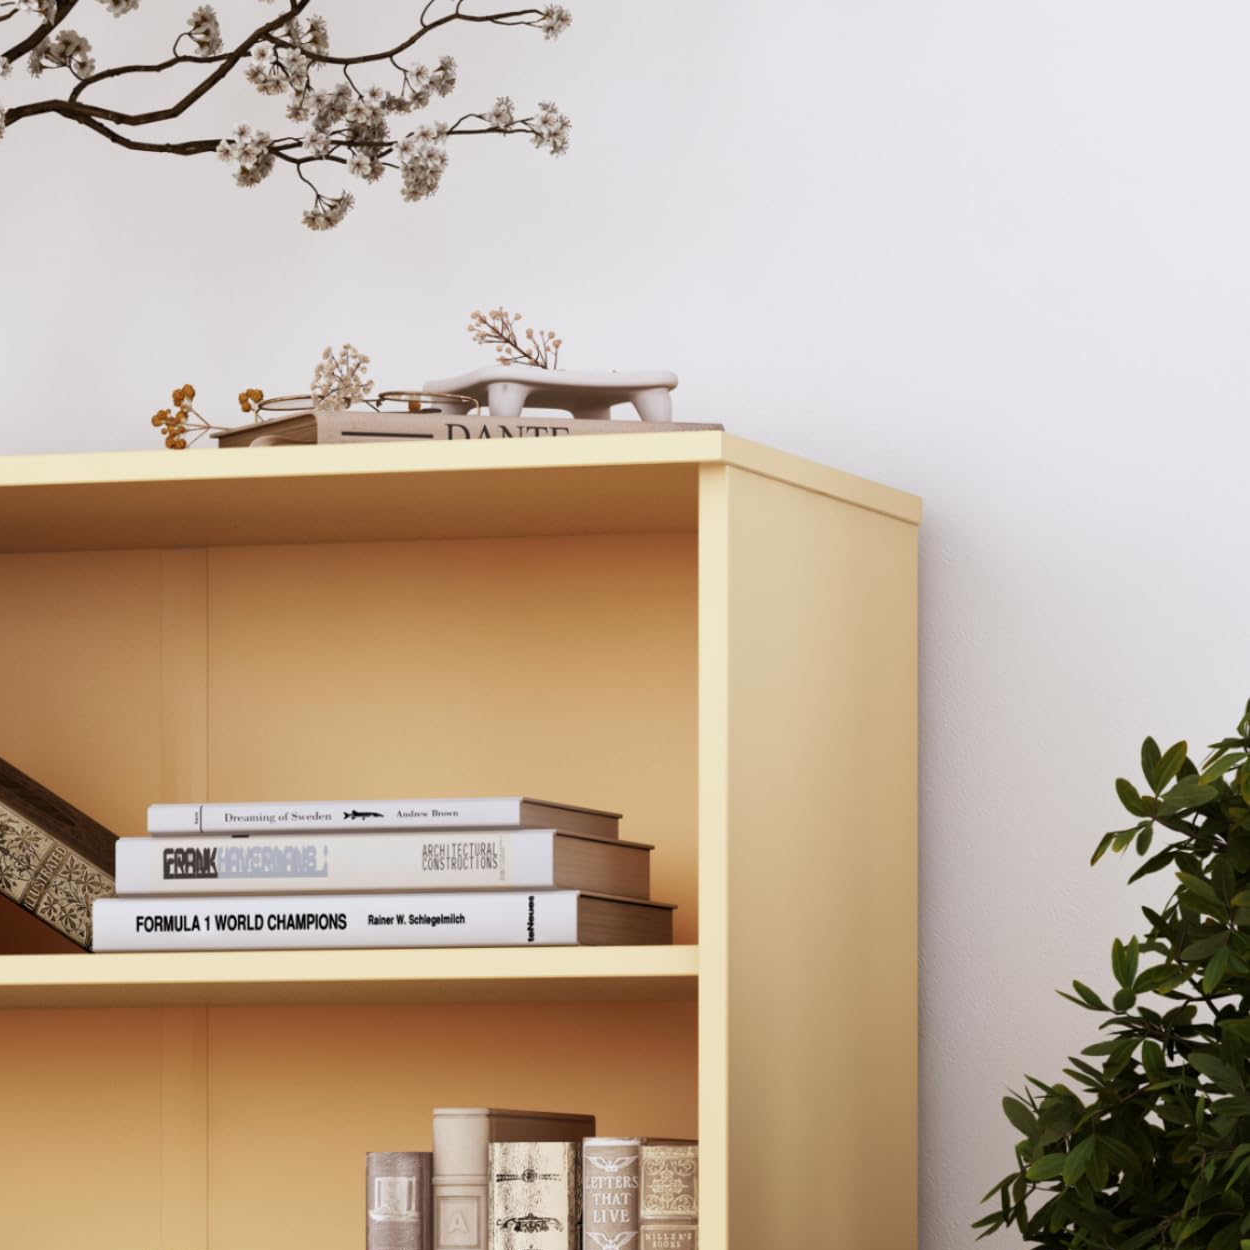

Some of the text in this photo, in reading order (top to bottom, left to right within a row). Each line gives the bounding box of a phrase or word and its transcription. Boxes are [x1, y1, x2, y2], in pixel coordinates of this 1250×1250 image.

[224, 811, 332, 823] Dreaming of Sweden
[396, 809, 459, 818] Andrew Brown
[422, 842, 497, 857] ARCHITECTURAL
[163, 847, 218, 879] FRANK
[422, 856, 498, 871] CONSTRUCTIONS
[22, 846, 67, 911] ILLUSTRATED
[136, 913, 348, 932] FORMULA 1 WORLD CHAMPIONS
[368, 913, 465, 927] Rainer W. Schlegelmilch
[586, 1175, 638, 1189] LETTERS
[592, 1193, 631, 1206] THAT
[447, 1210, 470, 1233] A
[593, 1209, 630, 1223] LIVE
